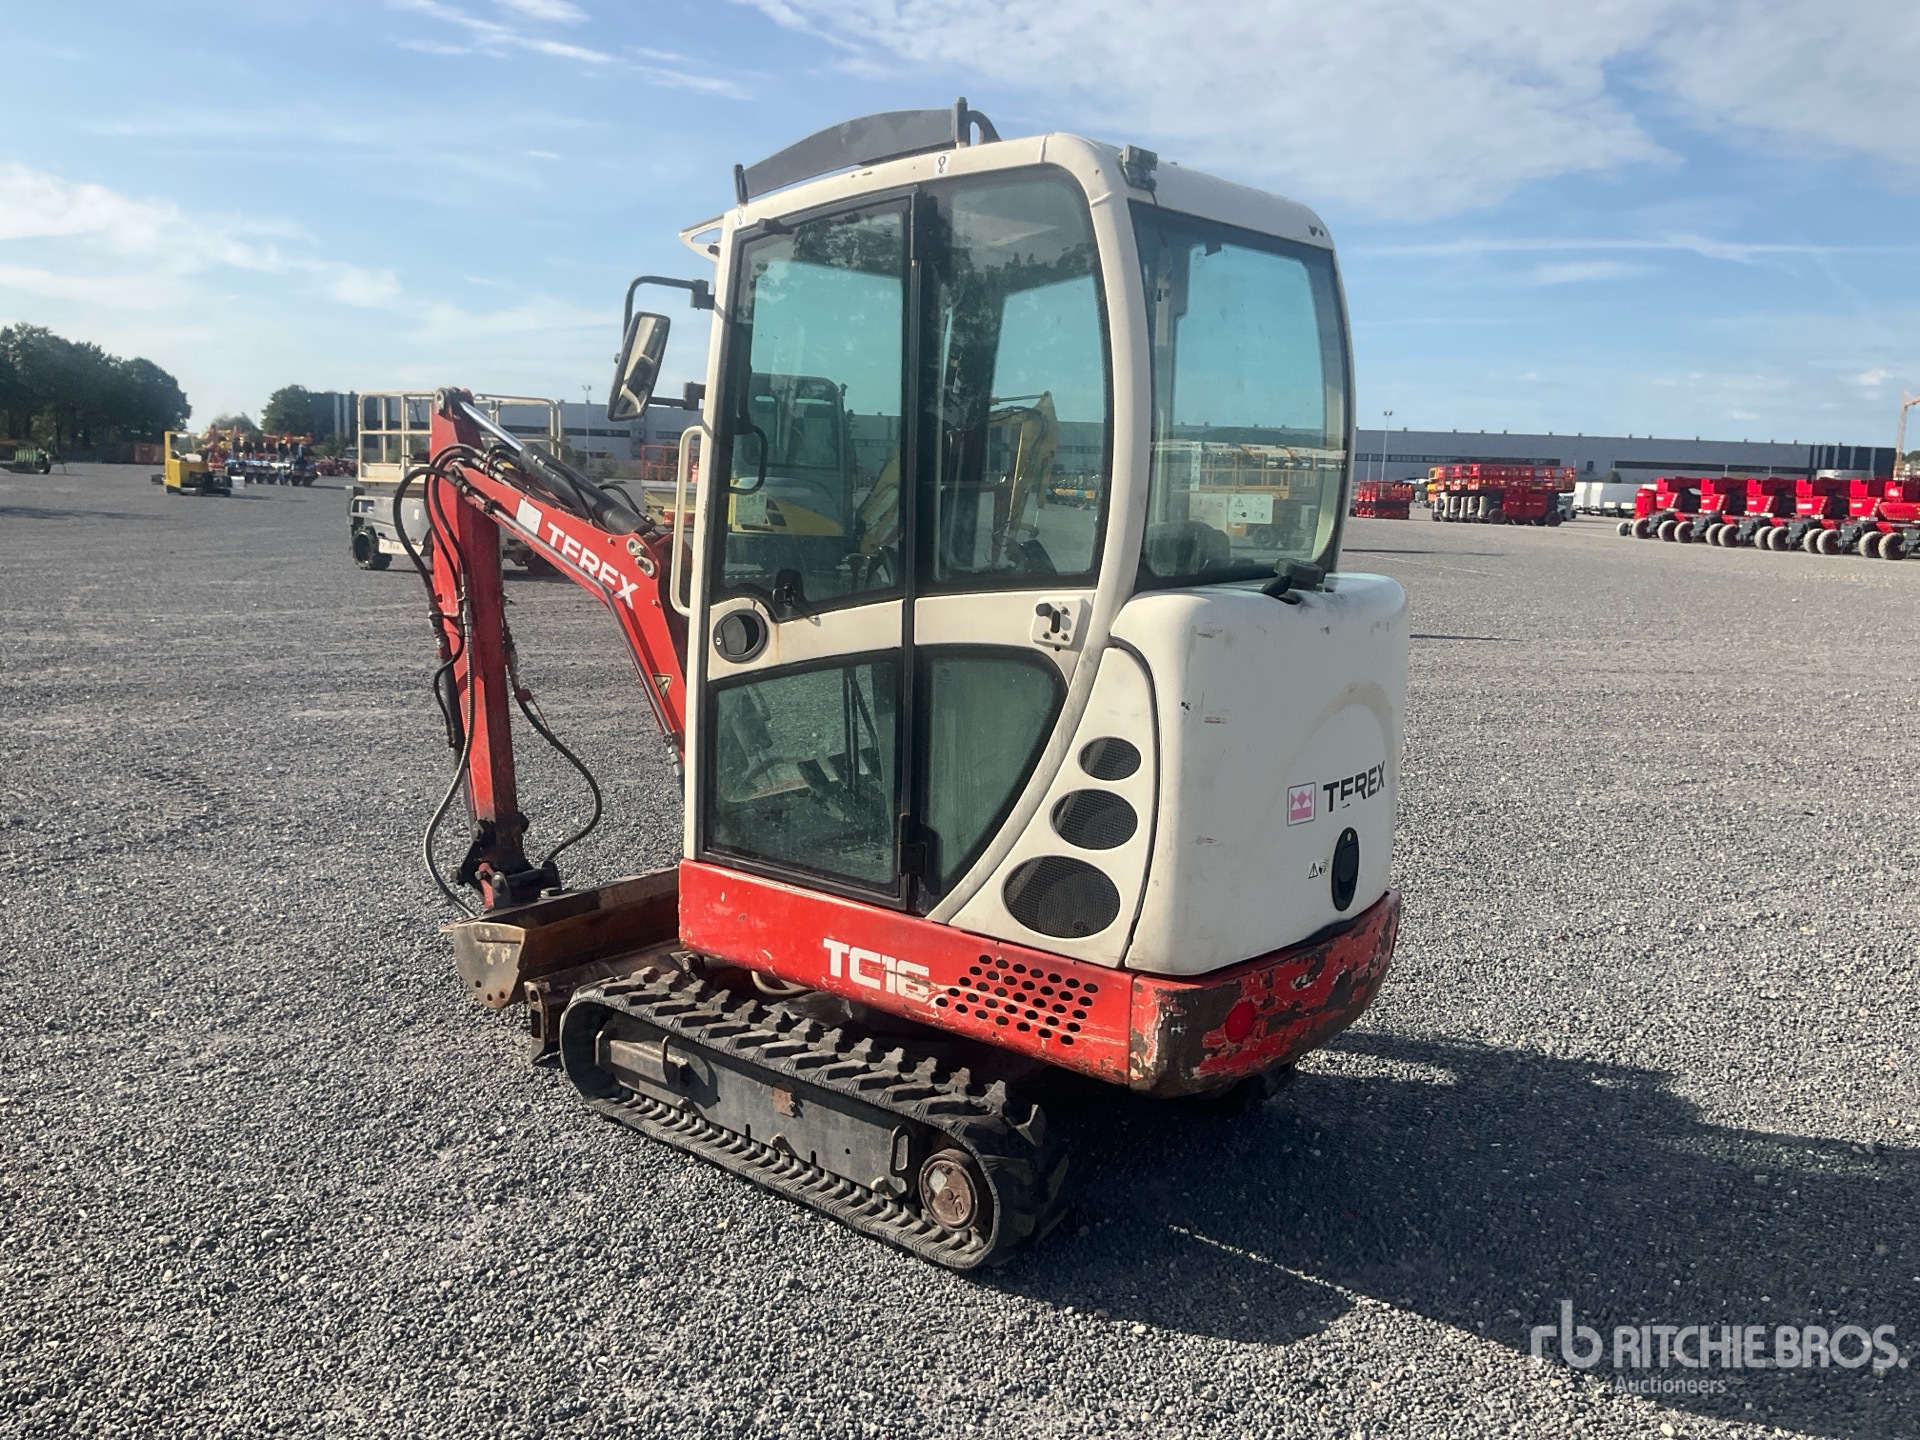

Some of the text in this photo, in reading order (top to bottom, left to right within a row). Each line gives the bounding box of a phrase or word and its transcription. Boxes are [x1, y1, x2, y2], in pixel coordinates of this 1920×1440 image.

[547, 522, 639, 609] TEREX
[1323, 760, 1385, 813] TEREX
[823, 937, 930, 1003] TC16
